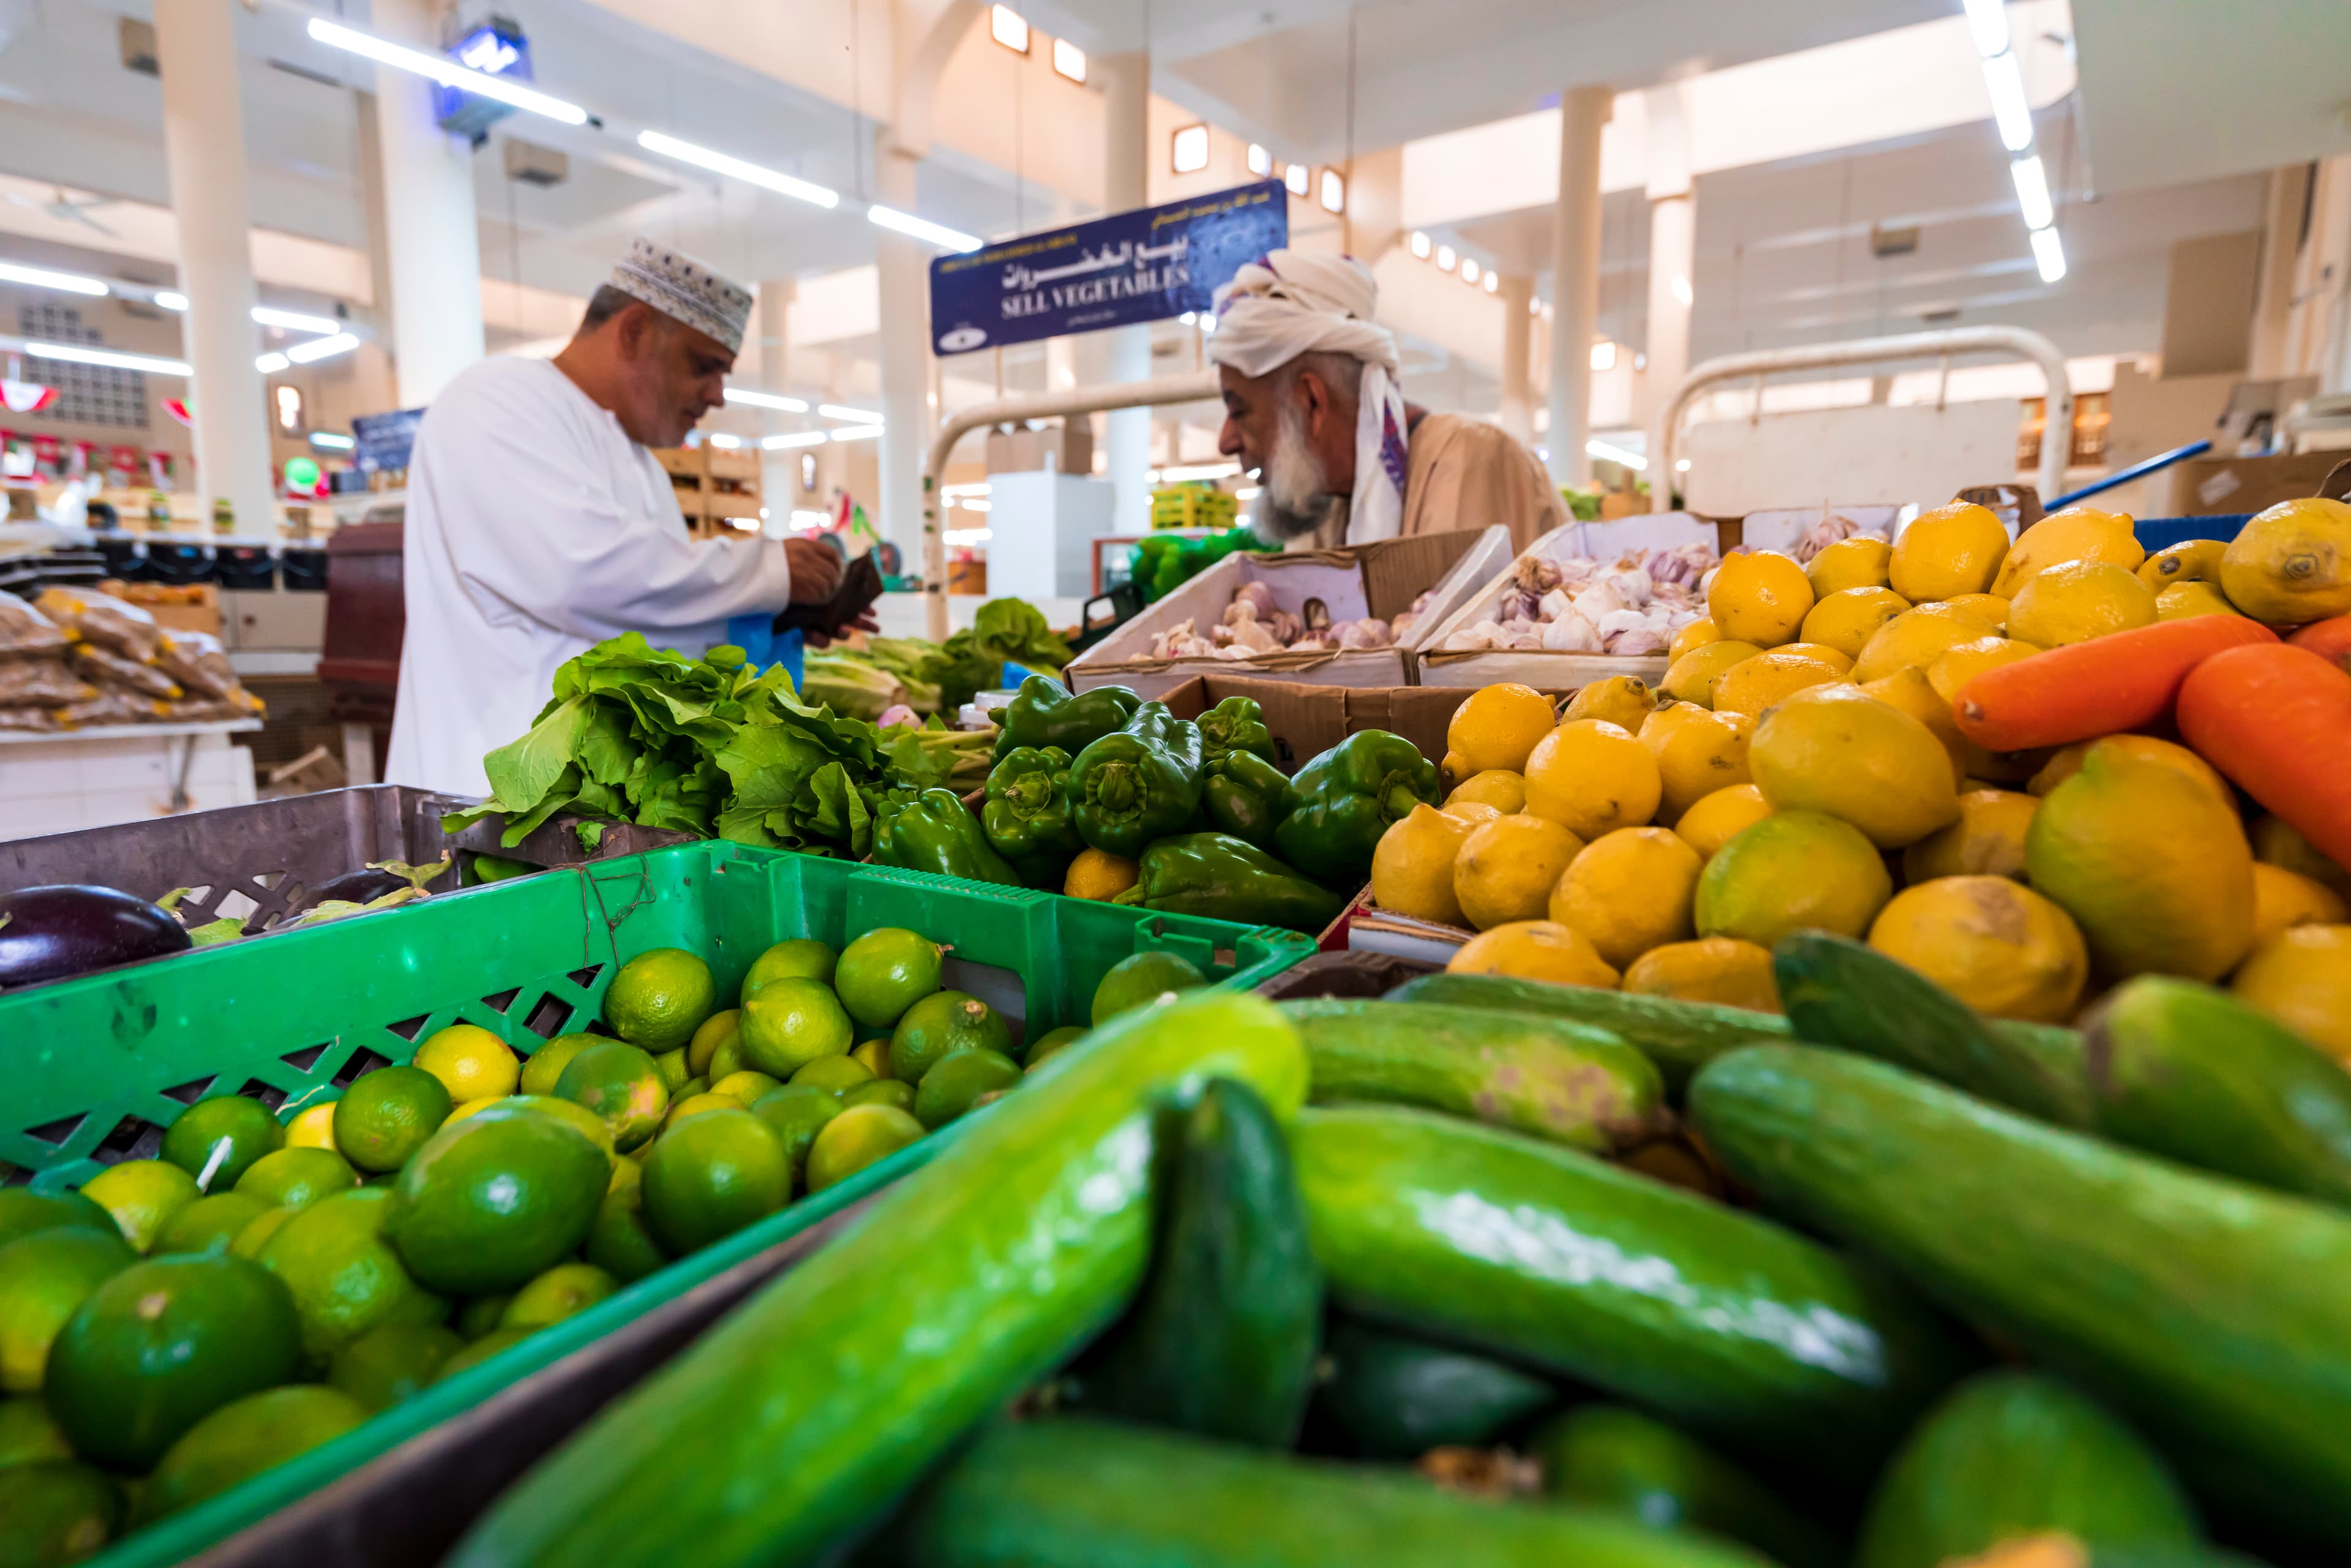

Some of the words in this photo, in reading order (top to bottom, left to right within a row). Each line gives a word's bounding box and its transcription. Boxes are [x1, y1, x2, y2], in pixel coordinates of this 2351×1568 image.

[1002, 239, 1133, 291] الخضروات
[1134, 234, 1189, 269] بيع
[1001, 290, 1051, 320] SELL
[1052, 264, 1190, 308] VEGETABLES
